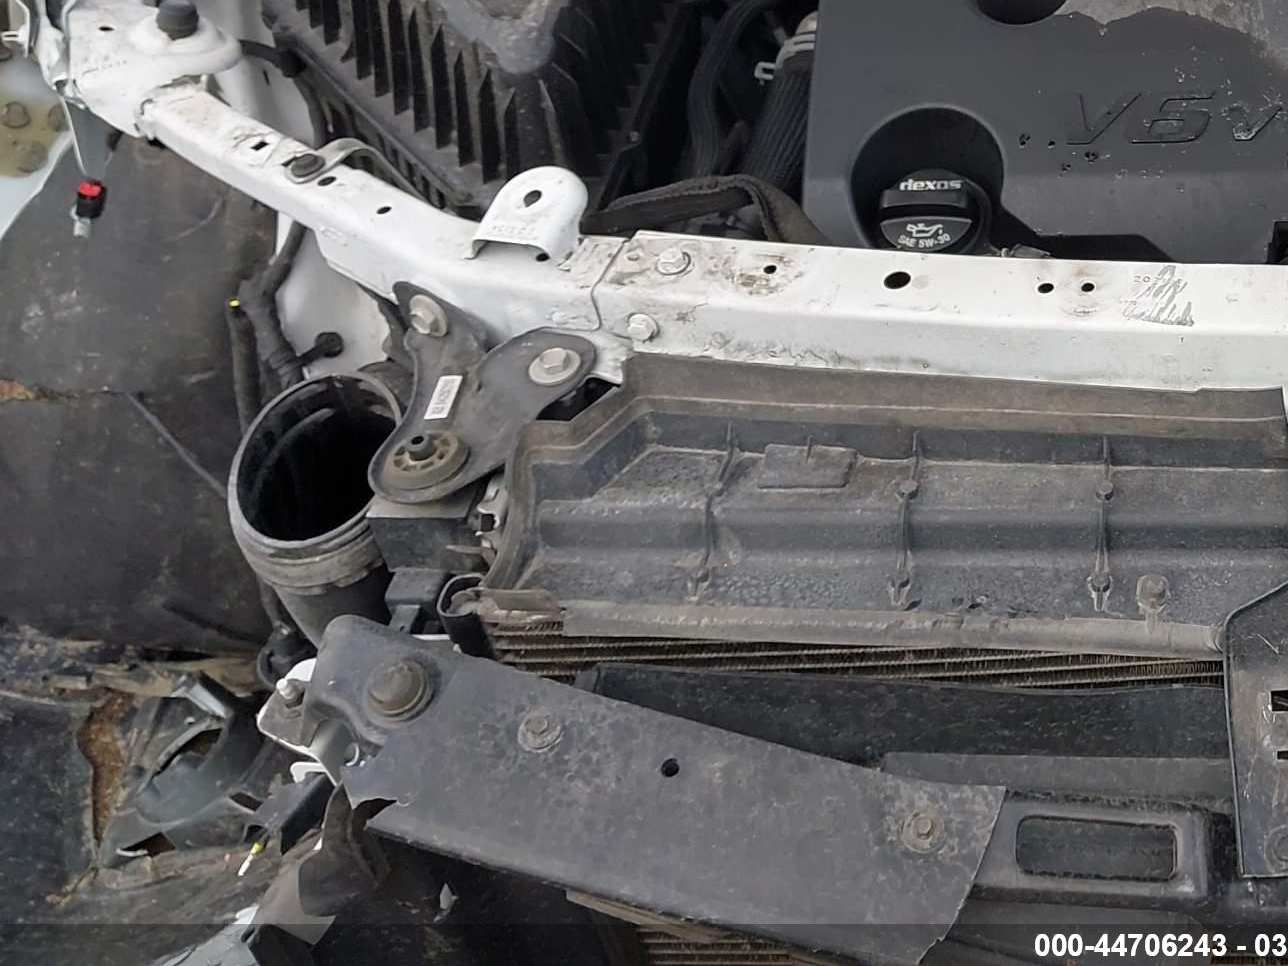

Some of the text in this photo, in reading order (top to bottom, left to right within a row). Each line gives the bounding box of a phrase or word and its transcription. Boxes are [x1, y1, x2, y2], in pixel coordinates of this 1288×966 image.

[1058, 91, 1217, 145] V6
[899, 178, 963, 191] dexos
[897, 233, 951, 248] SAE 5W-30
